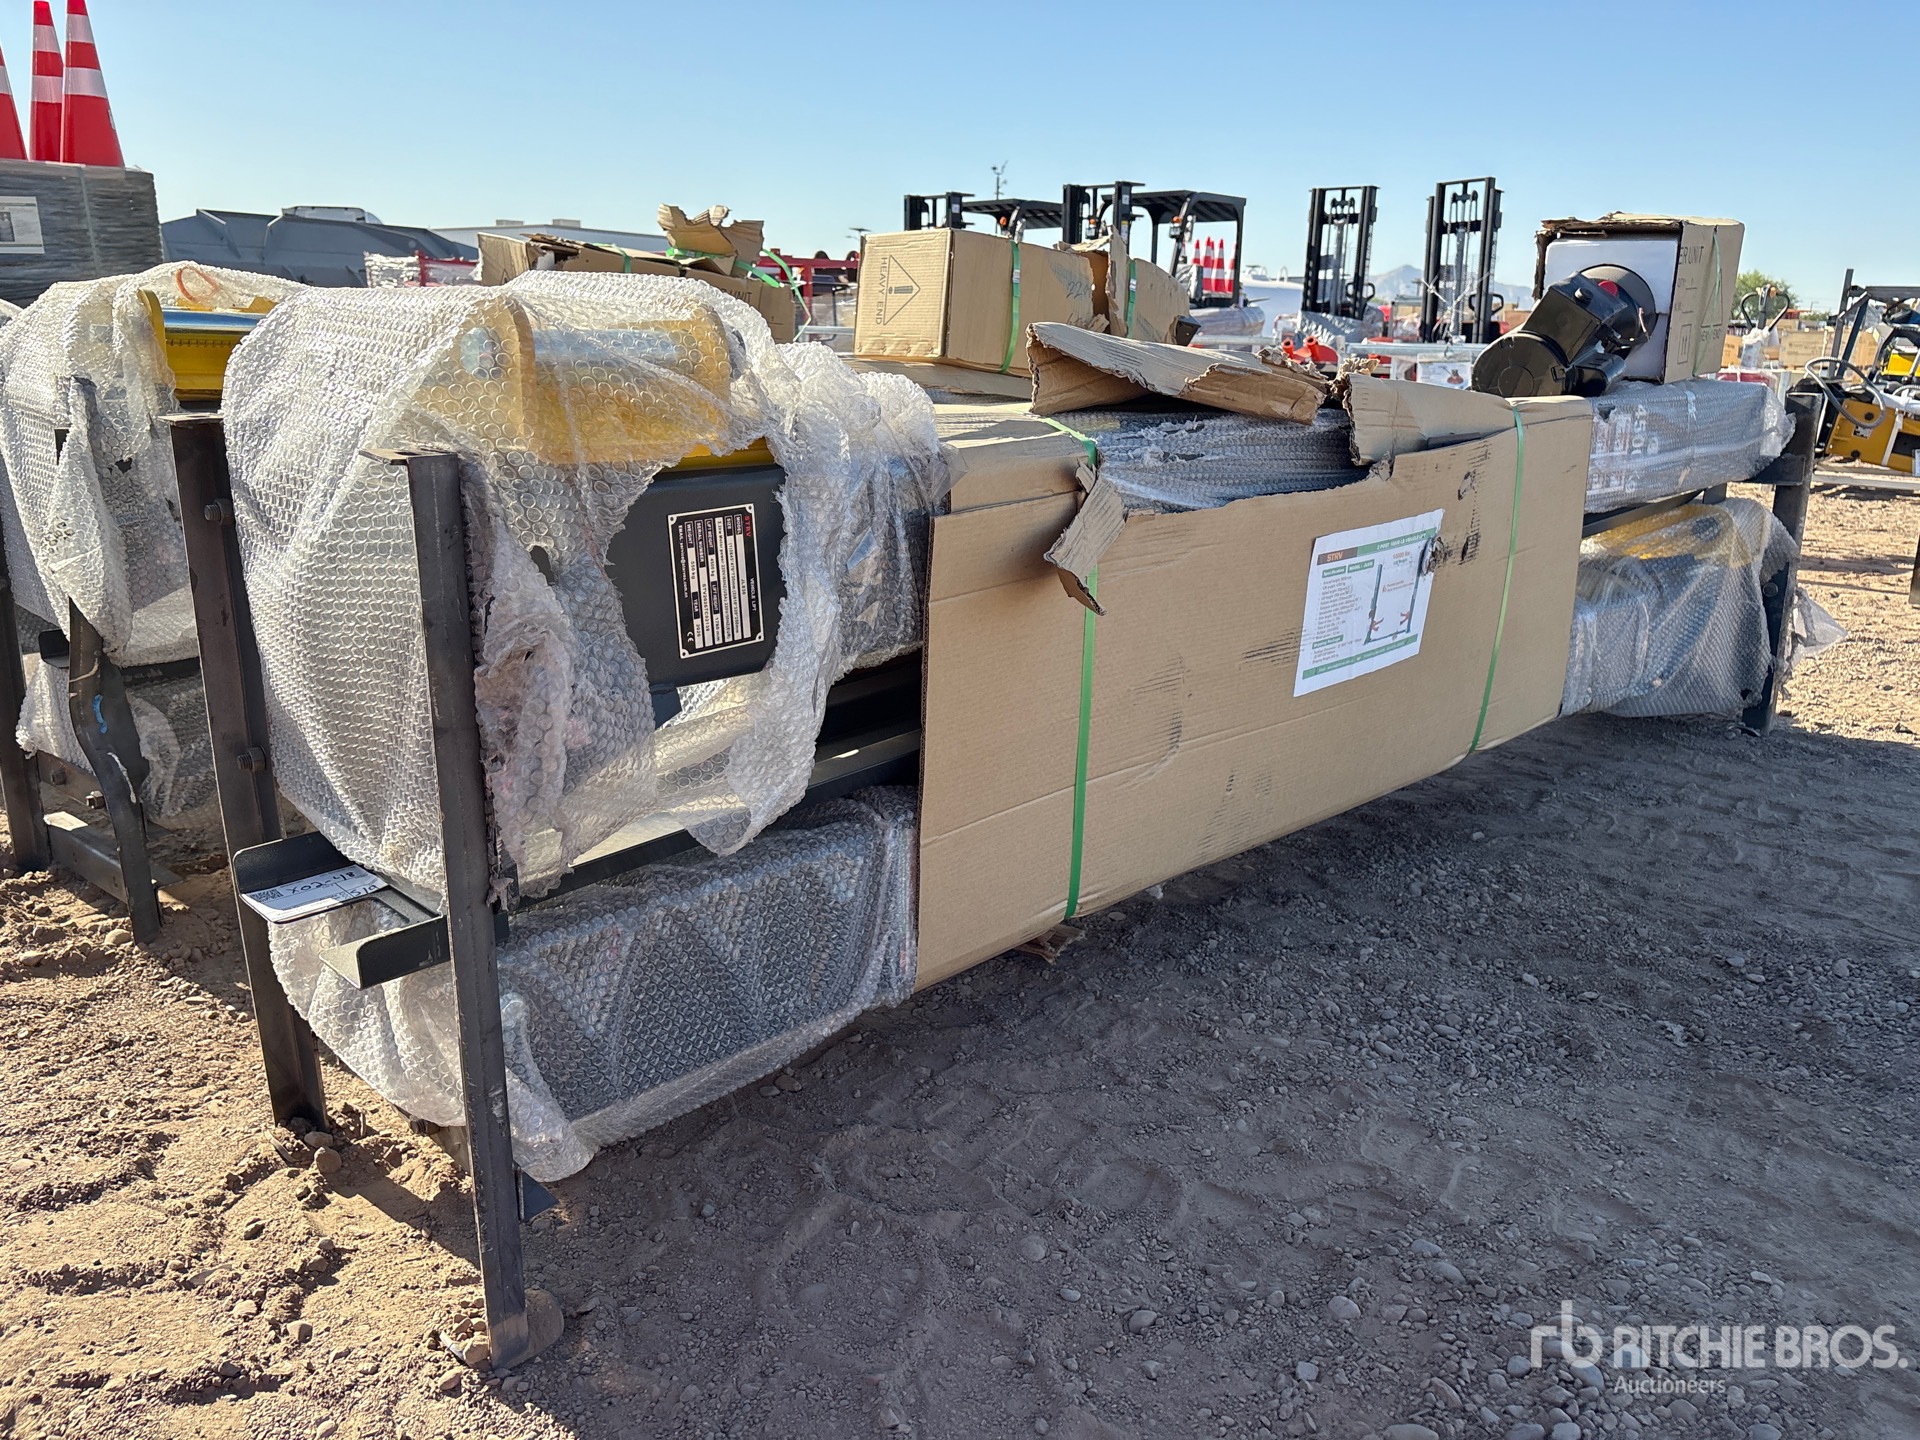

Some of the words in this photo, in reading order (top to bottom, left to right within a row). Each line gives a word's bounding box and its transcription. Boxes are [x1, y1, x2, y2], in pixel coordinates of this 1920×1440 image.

[879, 257, 888, 295] HEAVY
[876, 301, 884, 325] END
[1326, 552, 1344, 562] STRV
